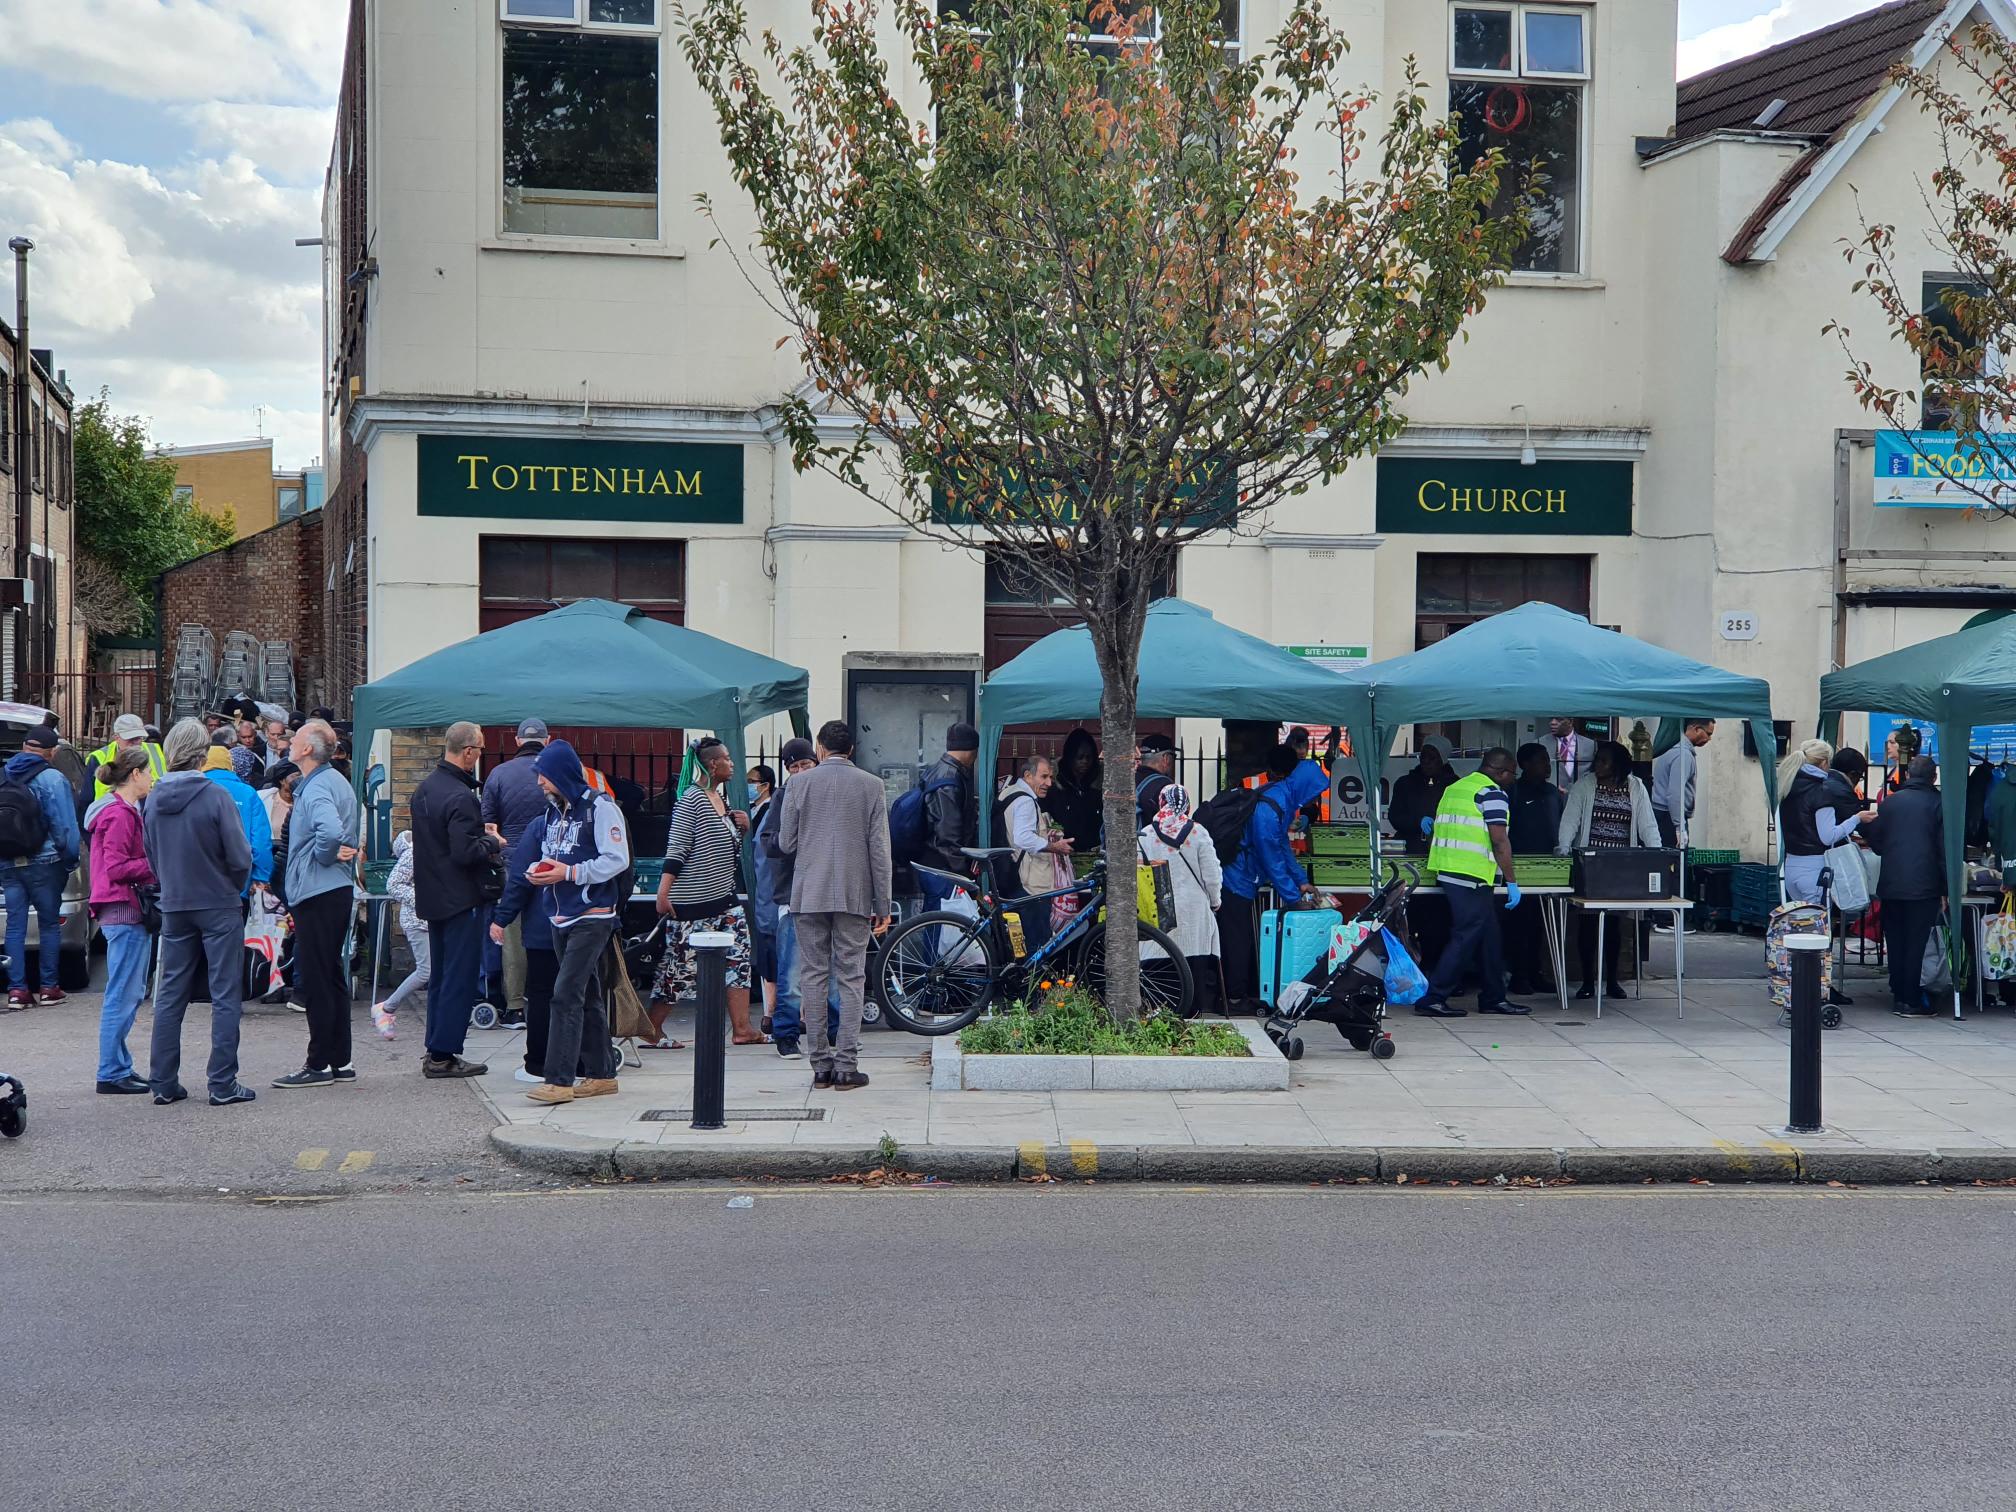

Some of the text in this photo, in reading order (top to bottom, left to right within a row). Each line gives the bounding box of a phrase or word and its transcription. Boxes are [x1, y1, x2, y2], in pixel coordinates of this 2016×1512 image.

[457, 455, 703, 496] TOTTENHAM
[1912, 453, 1986, 478] FOOD
[1418, 479, 1567, 513] CHURCH
[1727, 619, 1751, 631] 255
[1304, 648, 1351, 656] SITE SAFETY
